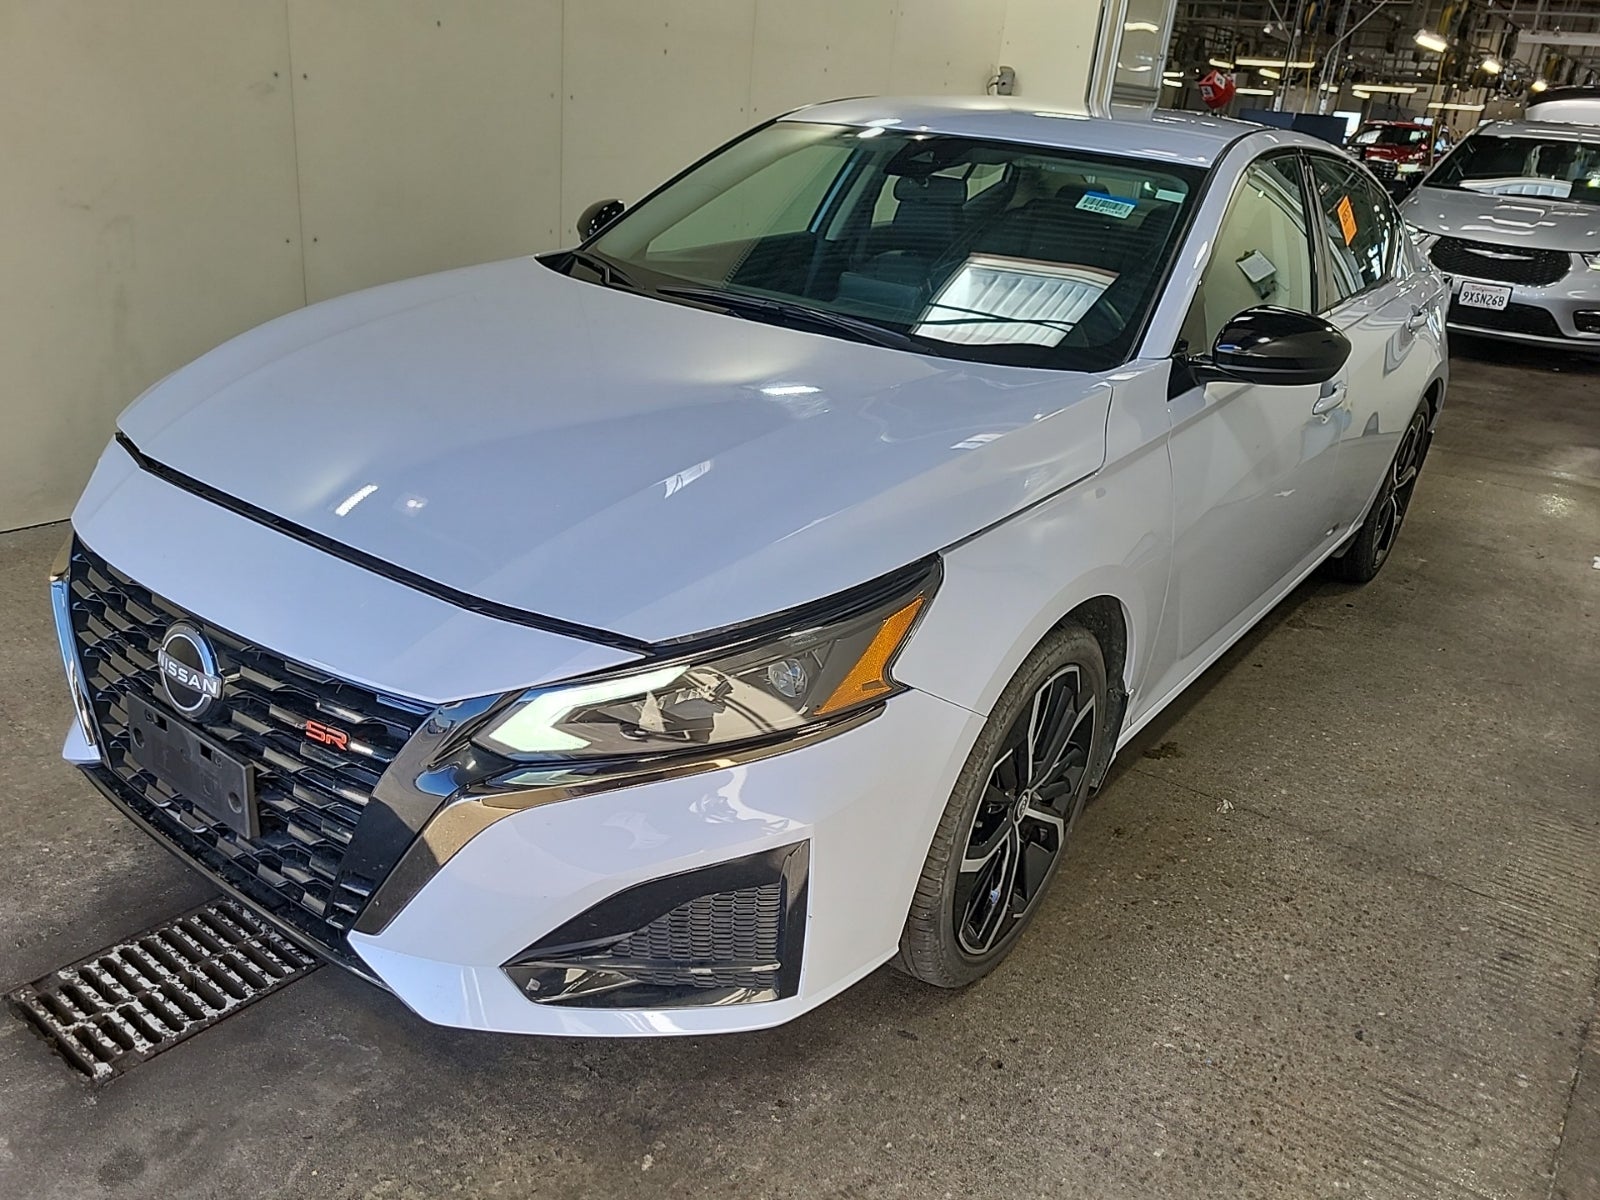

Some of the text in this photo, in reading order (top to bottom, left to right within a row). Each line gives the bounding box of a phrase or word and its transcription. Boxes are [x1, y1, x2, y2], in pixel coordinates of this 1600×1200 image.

[1462, 291, 1505, 307] 9XSN268
[159, 653, 217, 695] NISSAN
[306, 720, 348, 752] SR
